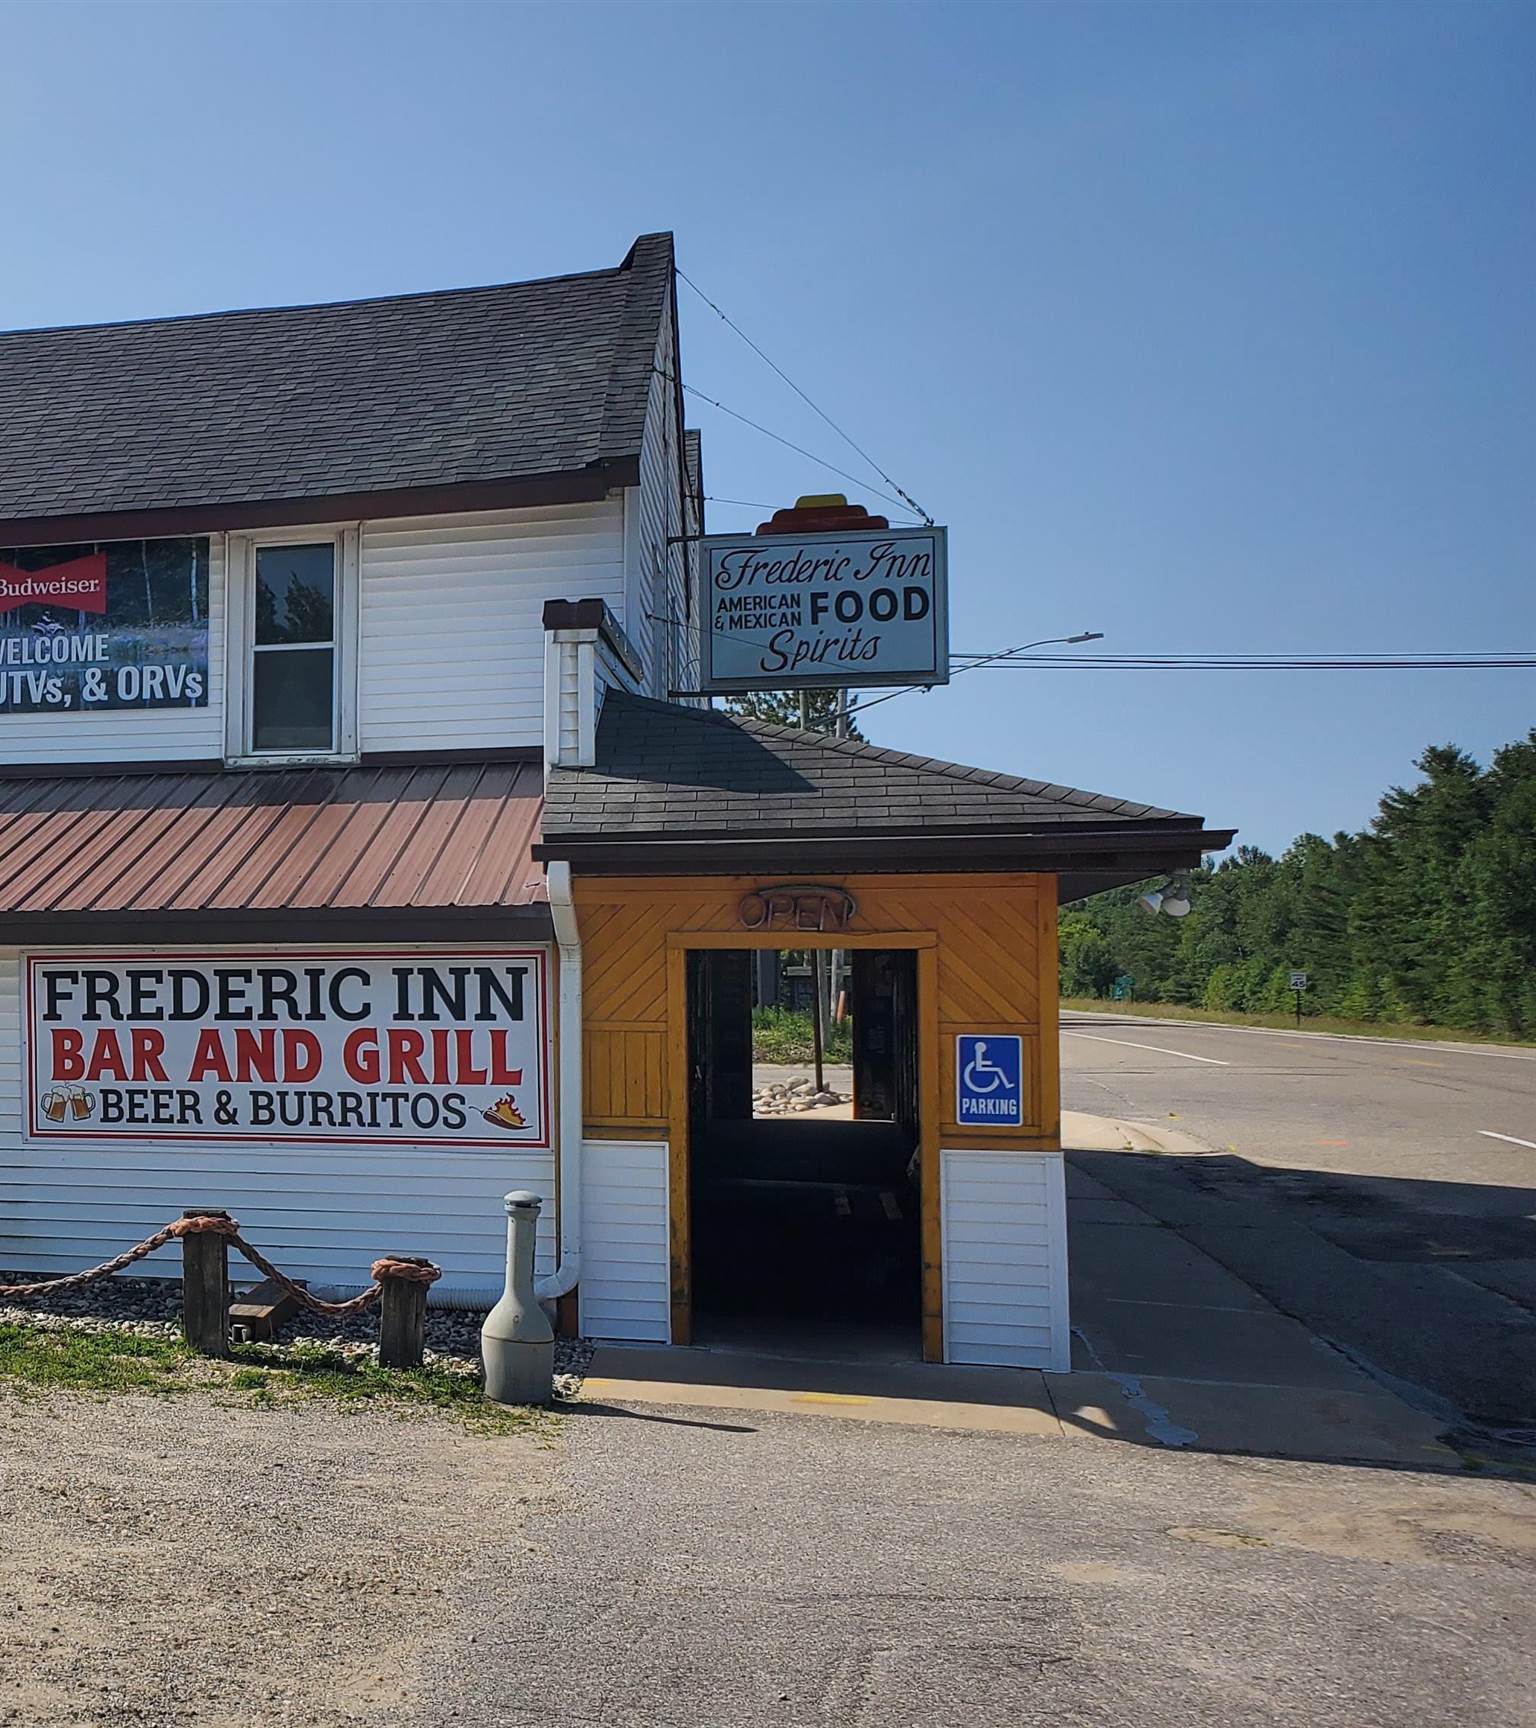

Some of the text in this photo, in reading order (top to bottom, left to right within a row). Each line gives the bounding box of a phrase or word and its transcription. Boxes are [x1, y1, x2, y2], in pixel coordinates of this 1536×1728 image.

[714, 542, 931, 590] Frederic Inn
[714, 611, 802, 631] & MEXICAN
[717, 593, 801, 613] AMERICAN
[810, 586, 930, 625] FOOD
[760, 628, 882, 673] Spirits
[82, 666, 109, 702] &
[117, 664, 203, 700] ORVs
[739, 894, 850, 931] OPEN
[41, 966, 529, 1022] FREDERIC INN
[50, 1027, 524, 1086] BAR AND GRILL
[99, 1088, 467, 1130] BEER & BURRITOS
[962, 1098, 1017, 1115] PARKING
